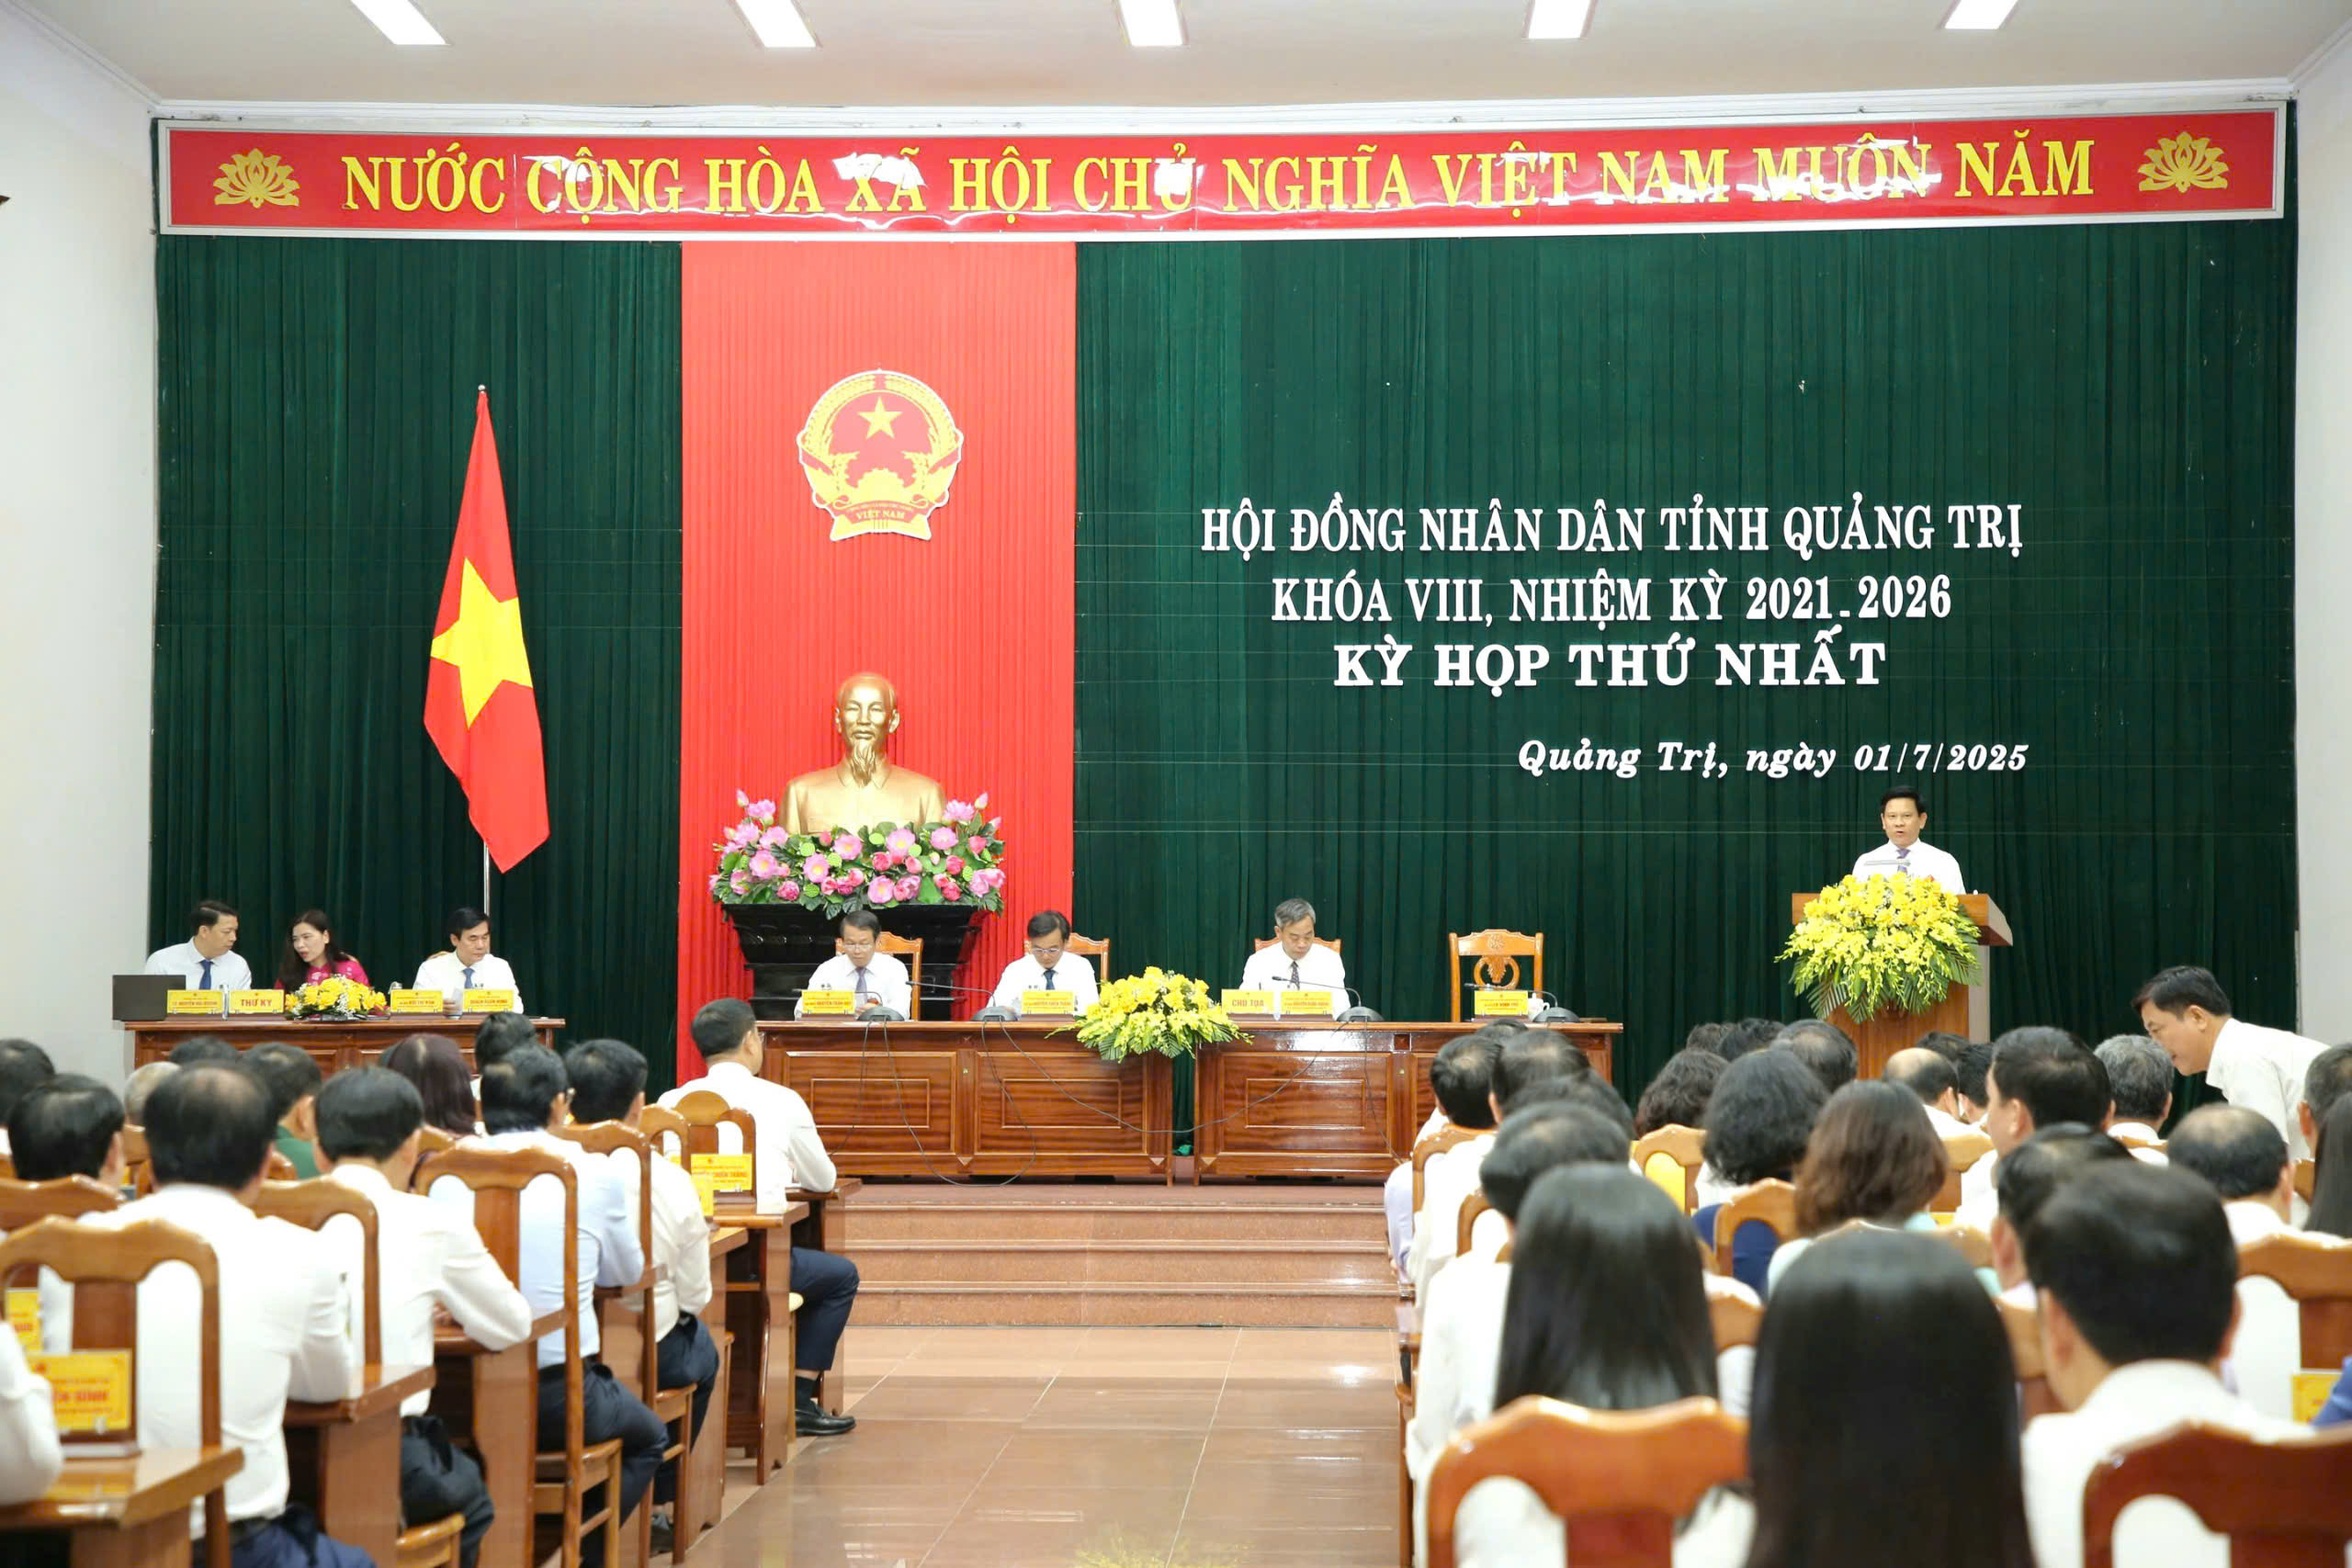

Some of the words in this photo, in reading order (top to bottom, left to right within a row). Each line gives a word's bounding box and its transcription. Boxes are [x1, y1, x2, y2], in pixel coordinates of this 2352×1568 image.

[341, 142, 506, 213] NƯỚC
[526, 146, 684, 224] CỘNG
[704, 145, 825, 213] HÒA
[948, 145, 1053, 224] HỘI
[1073, 143, 1196, 212] CHỦ
[1222, 144, 1416, 212] NGHĨA
[1431, 141, 1577, 218] VIỆT
[1598, 148, 1729, 205] NAM
[1752, 132, 1932, 203] MUÔN
[1955, 129, 2095, 197] NĂM
[1202, 498, 1275, 560] HỘI
[1291, 492, 1406, 551] ĐỒNG
[1419, 499, 1543, 551] NHÂN
[1557, 499, 1645, 551] DÂN
[1661, 493, 1769, 550] TỈNH
[1784, 492, 1934, 560] QUẢNG
[1949, 505, 2022, 557] TRỊ
[1272, 570, 1392, 621] KHÓA
[1405, 579, 1492, 626] VIII,
[1510, 569, 1651, 630] NHIỆM
[1669, 569, 1727, 620] KỲ
[1334, 634, 1412, 685] KỲ
[1434, 645, 1549, 696] HỌP
[1569, 632, 1695, 685] THỨ
[1715, 625, 1885, 685] NHẤT
[1519, 739, 1641, 778] Quảng
[1658, 742, 1727, 778] Trị,
[1747, 742, 1836, 778] ngày
[1855, 743, 2029, 773] 01/7/2025
